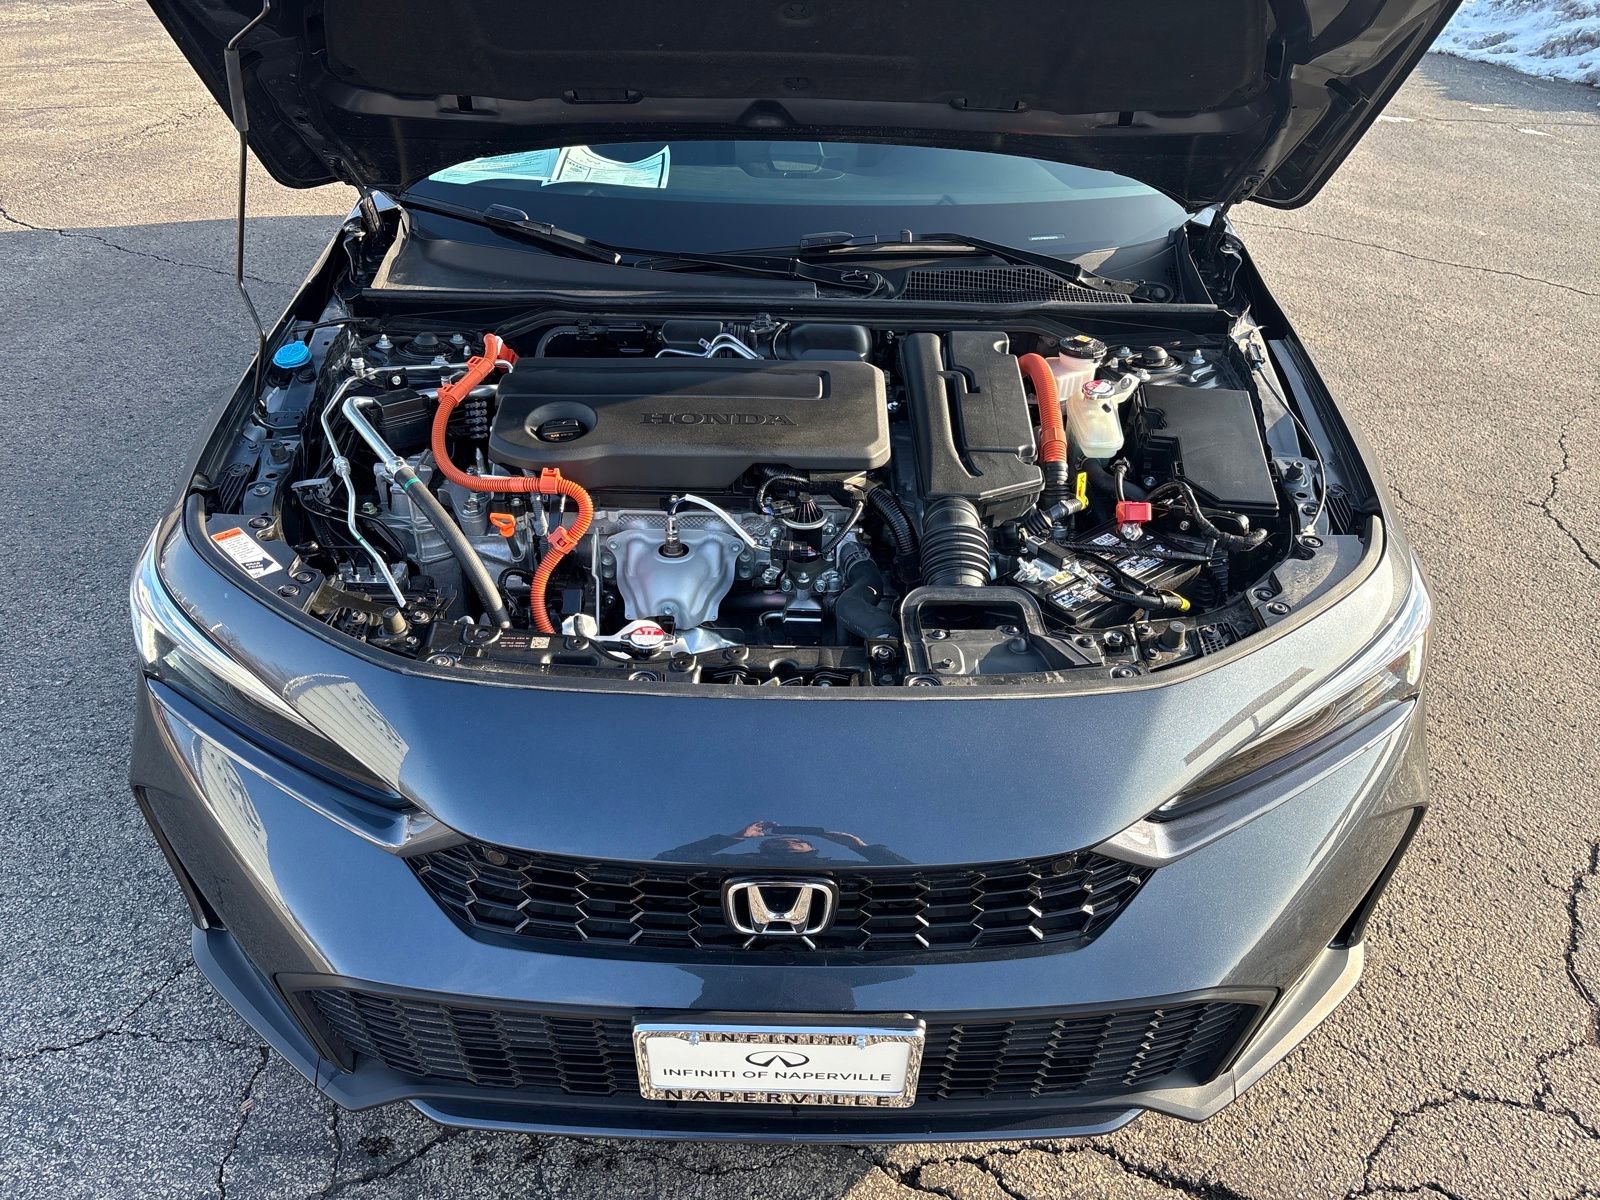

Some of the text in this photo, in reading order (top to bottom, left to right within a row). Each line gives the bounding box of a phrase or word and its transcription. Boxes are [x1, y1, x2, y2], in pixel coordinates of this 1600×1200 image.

[640, 412, 799, 427] HONDA
[705, 1032, 852, 1045] INFINITI
[663, 1068, 892, 1082] INFINITI OF NAPERVILLE
[664, 1089, 891, 1107] NAPERVILLE
